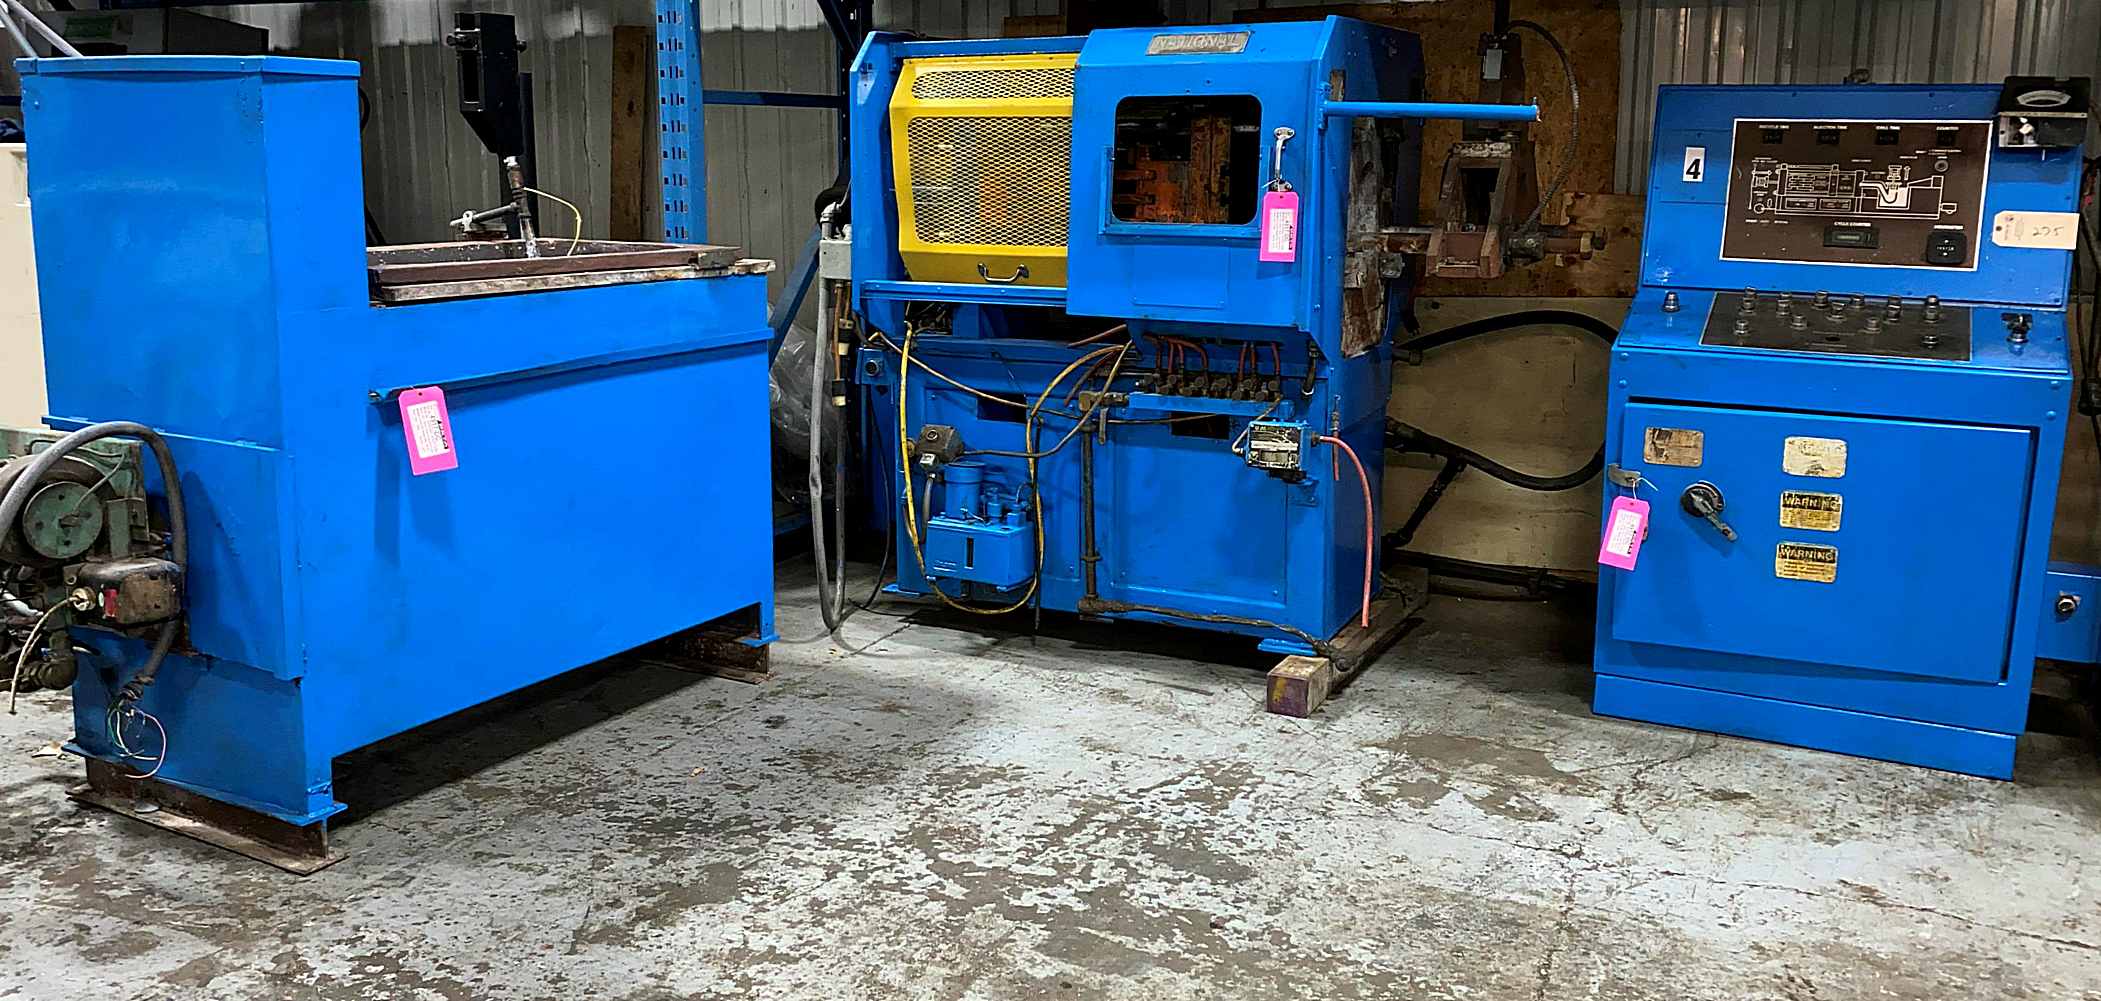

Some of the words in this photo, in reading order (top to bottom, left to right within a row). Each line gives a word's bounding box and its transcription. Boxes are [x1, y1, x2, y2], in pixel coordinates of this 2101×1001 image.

[1685, 158, 1701, 179] 4
[1783, 495, 1840, 510] WARNING
[1780, 545, 1834, 561] WARNING
